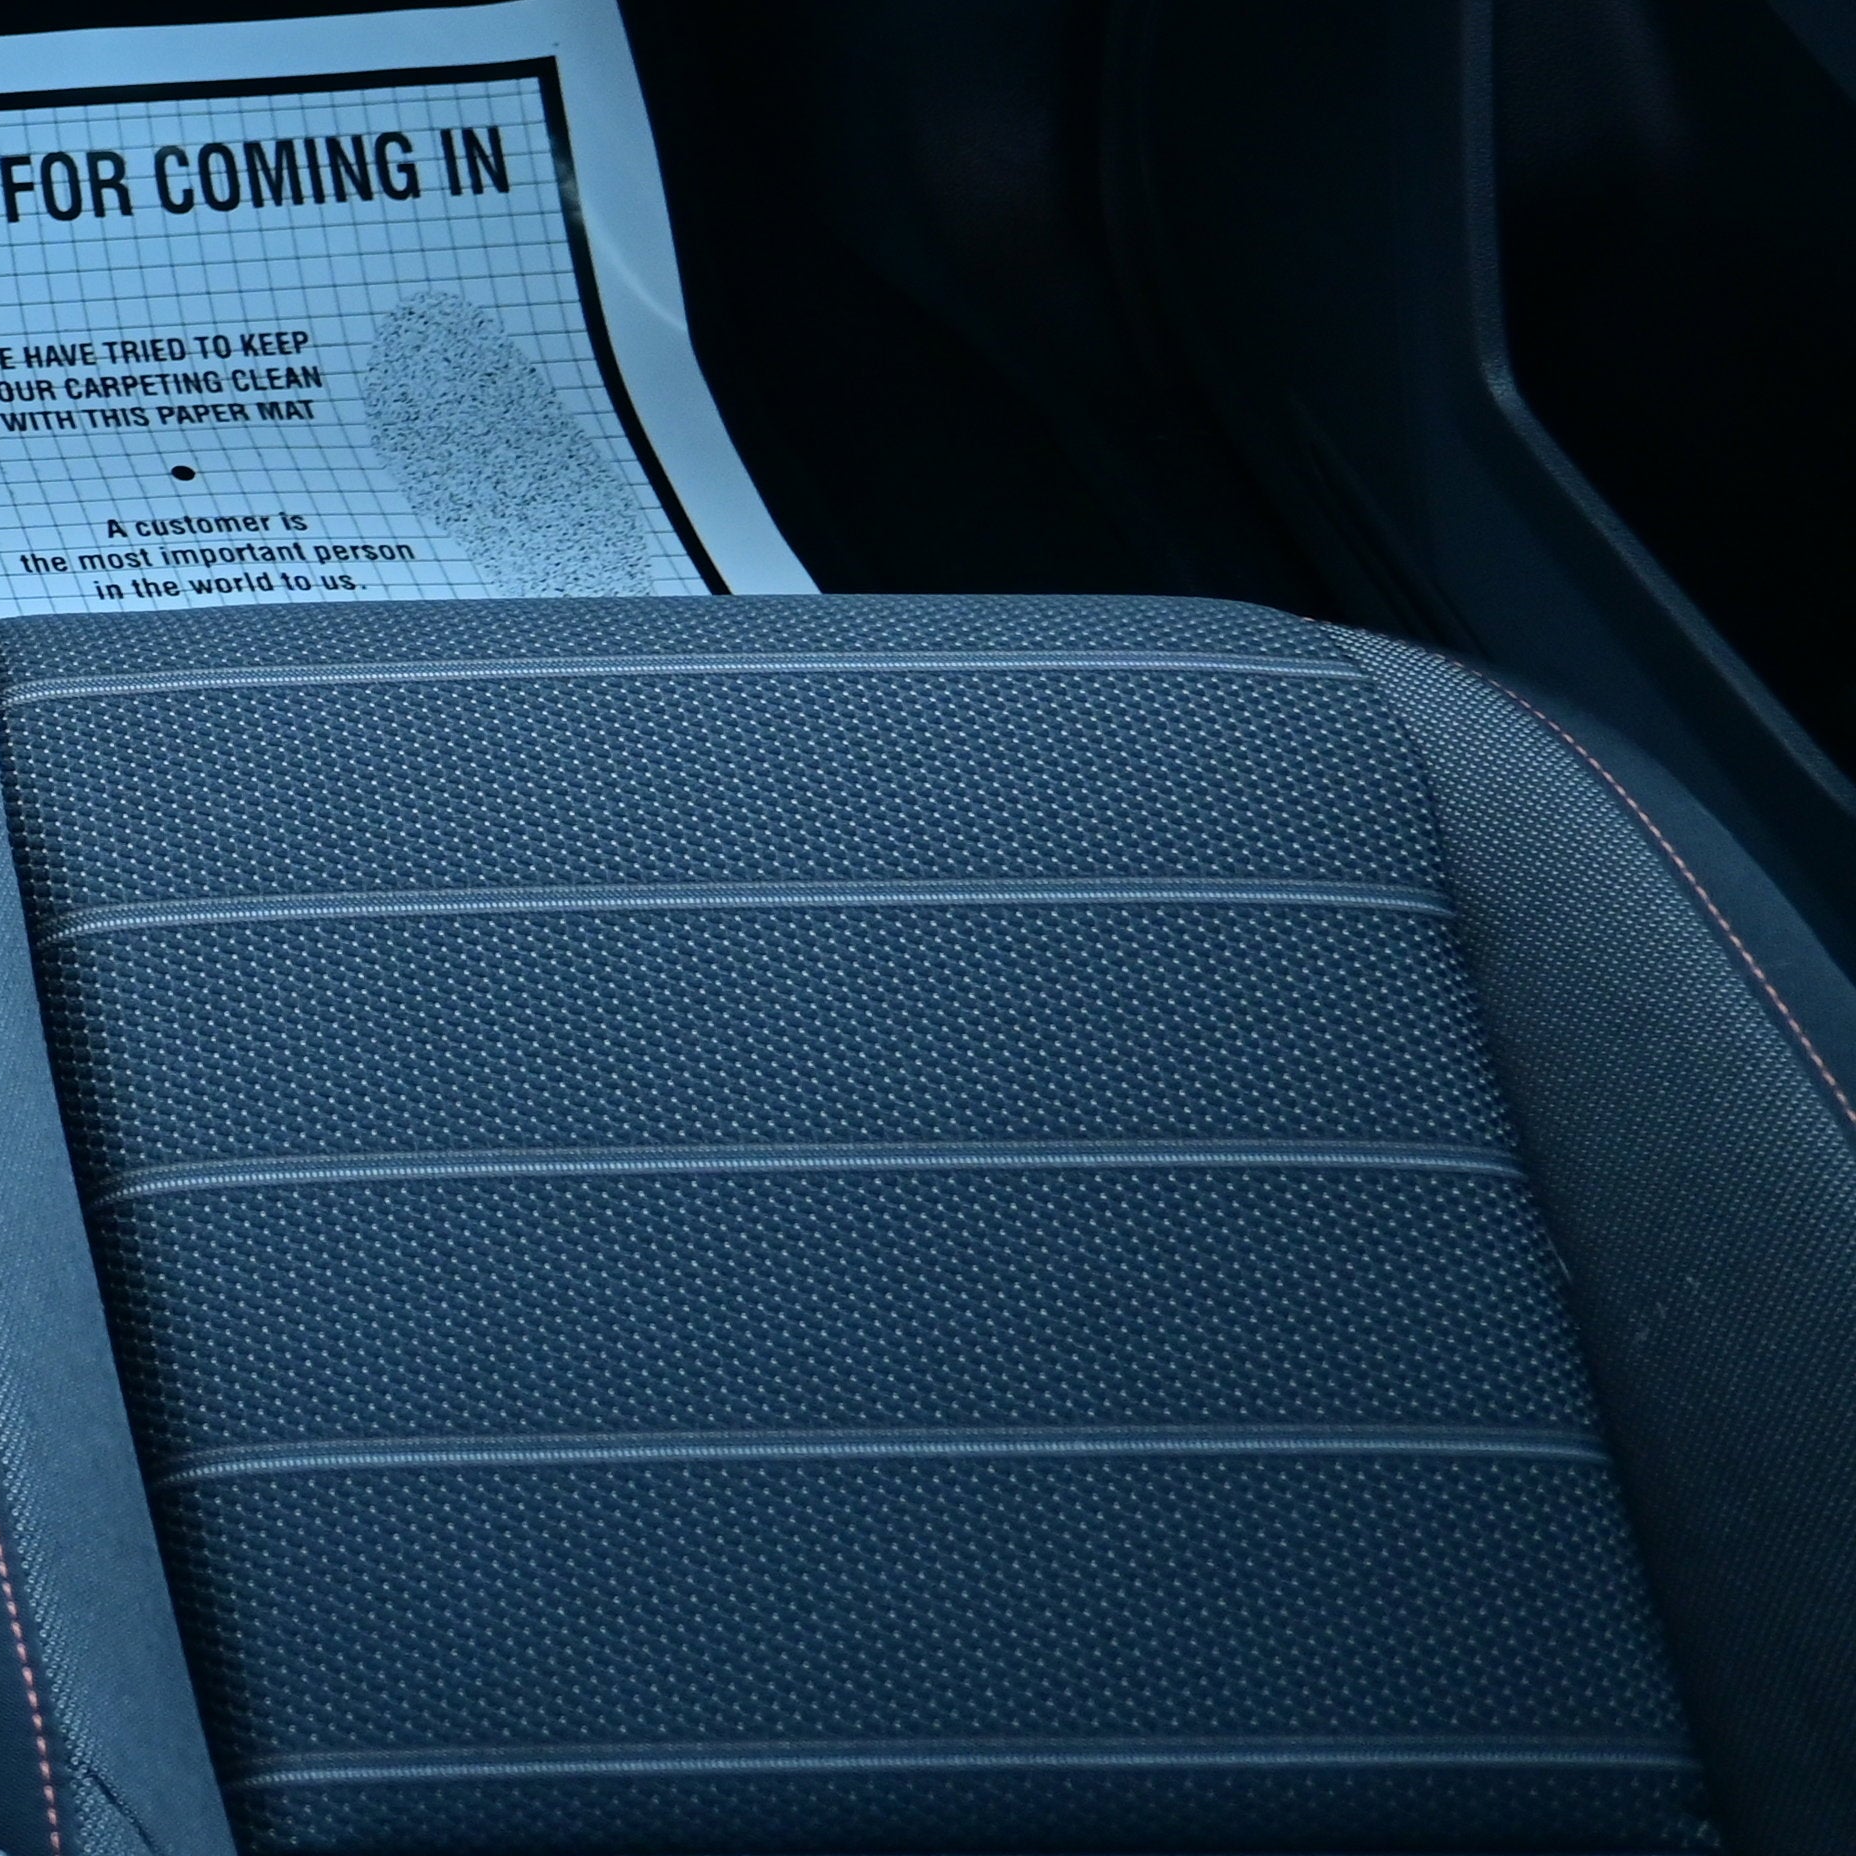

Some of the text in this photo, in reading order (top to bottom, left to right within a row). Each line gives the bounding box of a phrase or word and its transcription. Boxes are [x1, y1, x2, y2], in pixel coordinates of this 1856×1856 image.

[0, 151, 133, 223] FOR
[154, 132, 421, 215] COMING
[440, 126, 510, 196] IN
[24, 342, 97, 370] HAVE
[102, 337, 187, 364] TRIED
[193, 335, 232, 359] TO
[239, 330, 309, 357] KEEP
[64, 371, 224, 400] CARPETING
[231, 366, 323, 392] CLEAN
[0, 399, 317, 432] WITH THIS PAPER MAT
[106, 511, 309, 539] A customer is
[20, 542, 416, 574] the most important person
[94, 572, 368, 601] in the world to us.
